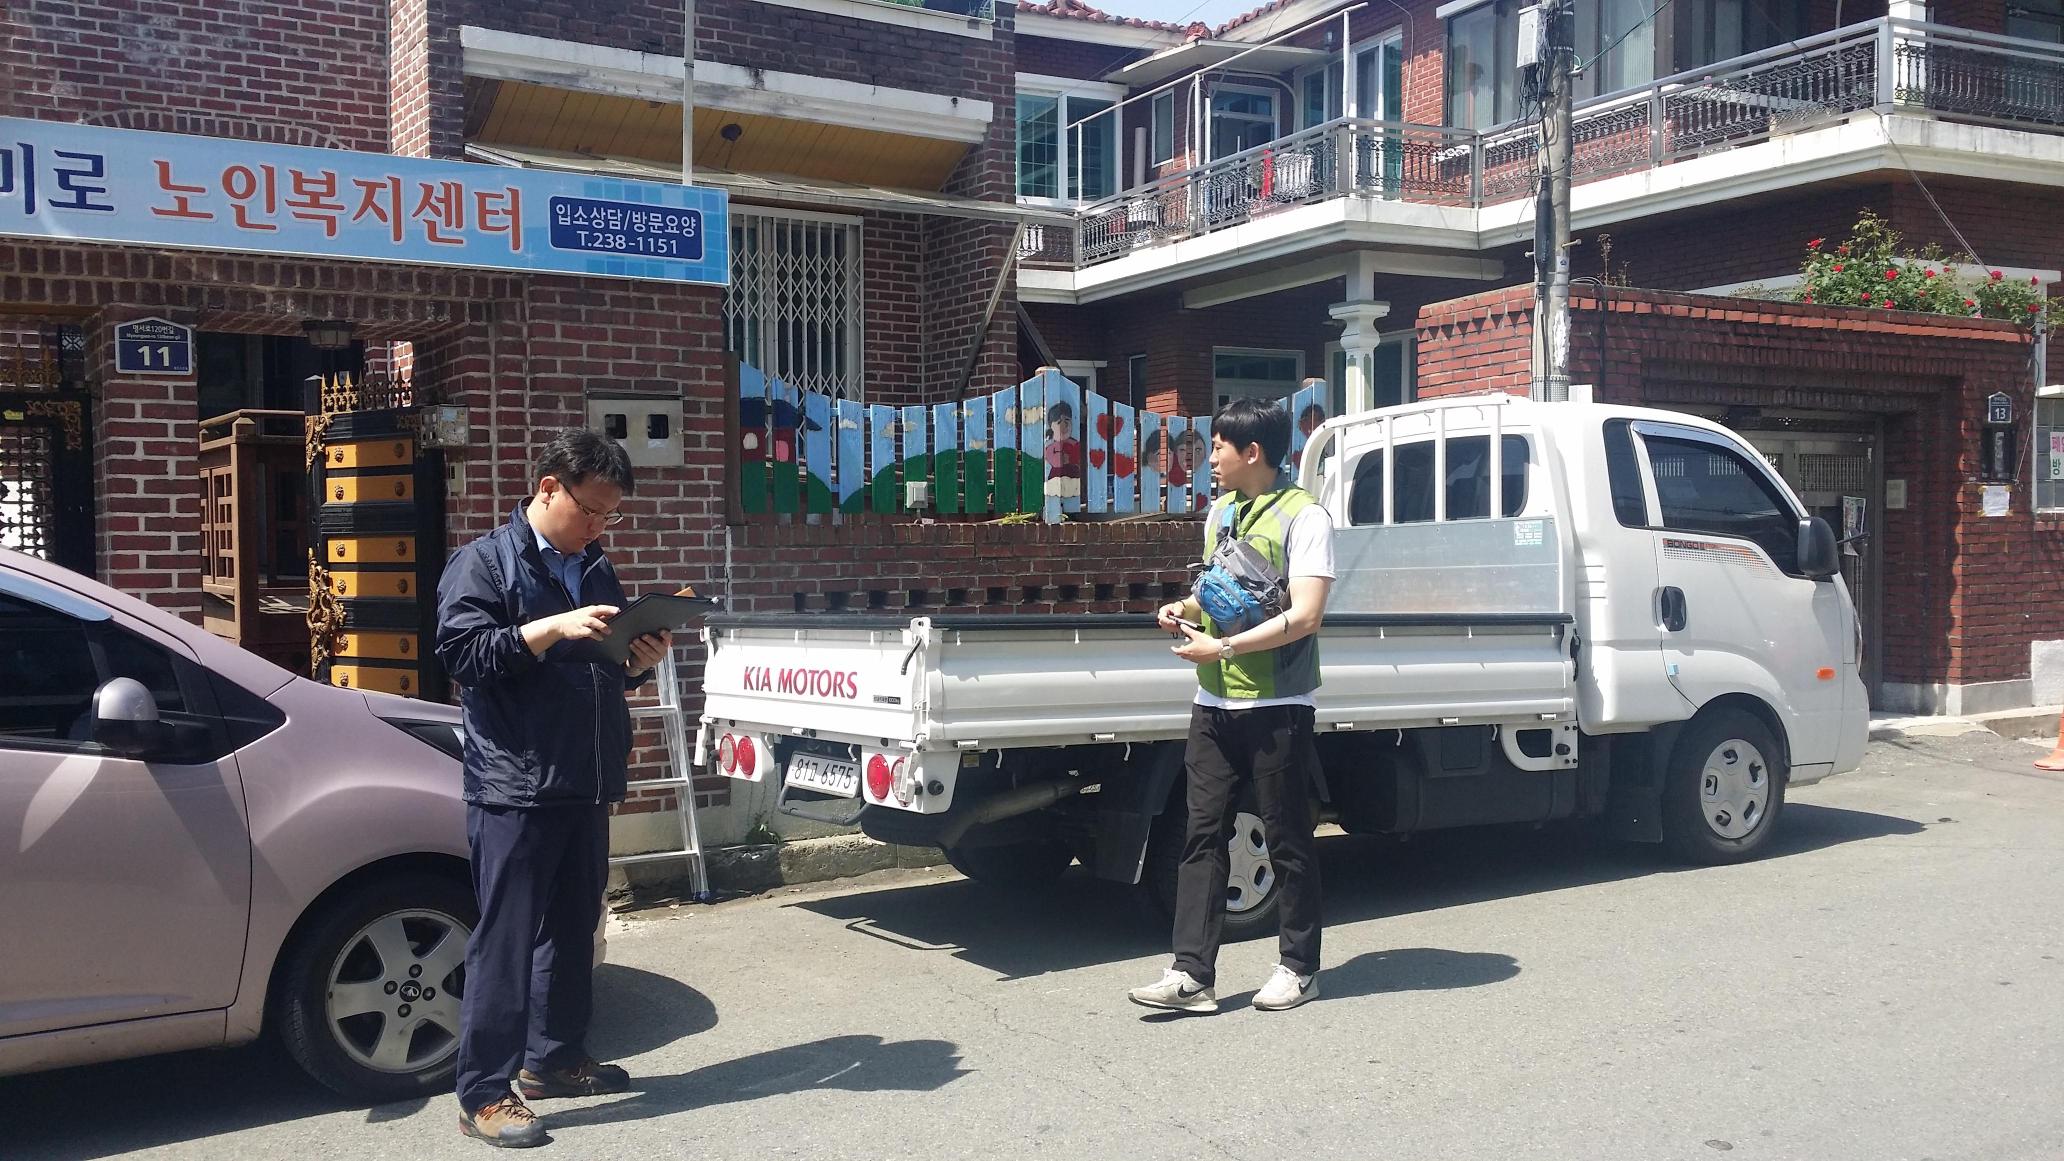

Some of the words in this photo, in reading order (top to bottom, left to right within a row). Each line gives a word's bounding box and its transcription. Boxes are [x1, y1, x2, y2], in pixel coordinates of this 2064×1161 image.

[151, 160, 521, 251] 노인복지센터
[555, 203, 697, 238] 입소상담/방문요양
[576, 230, 677, 254] T.238-1151
[137, 345, 170, 367] 11
[1995, 407, 2006, 420] 13
[743, 666, 772, 692] KIA
[777, 668, 858, 699] MOTORS
[821, 763, 854, 789] 6575
